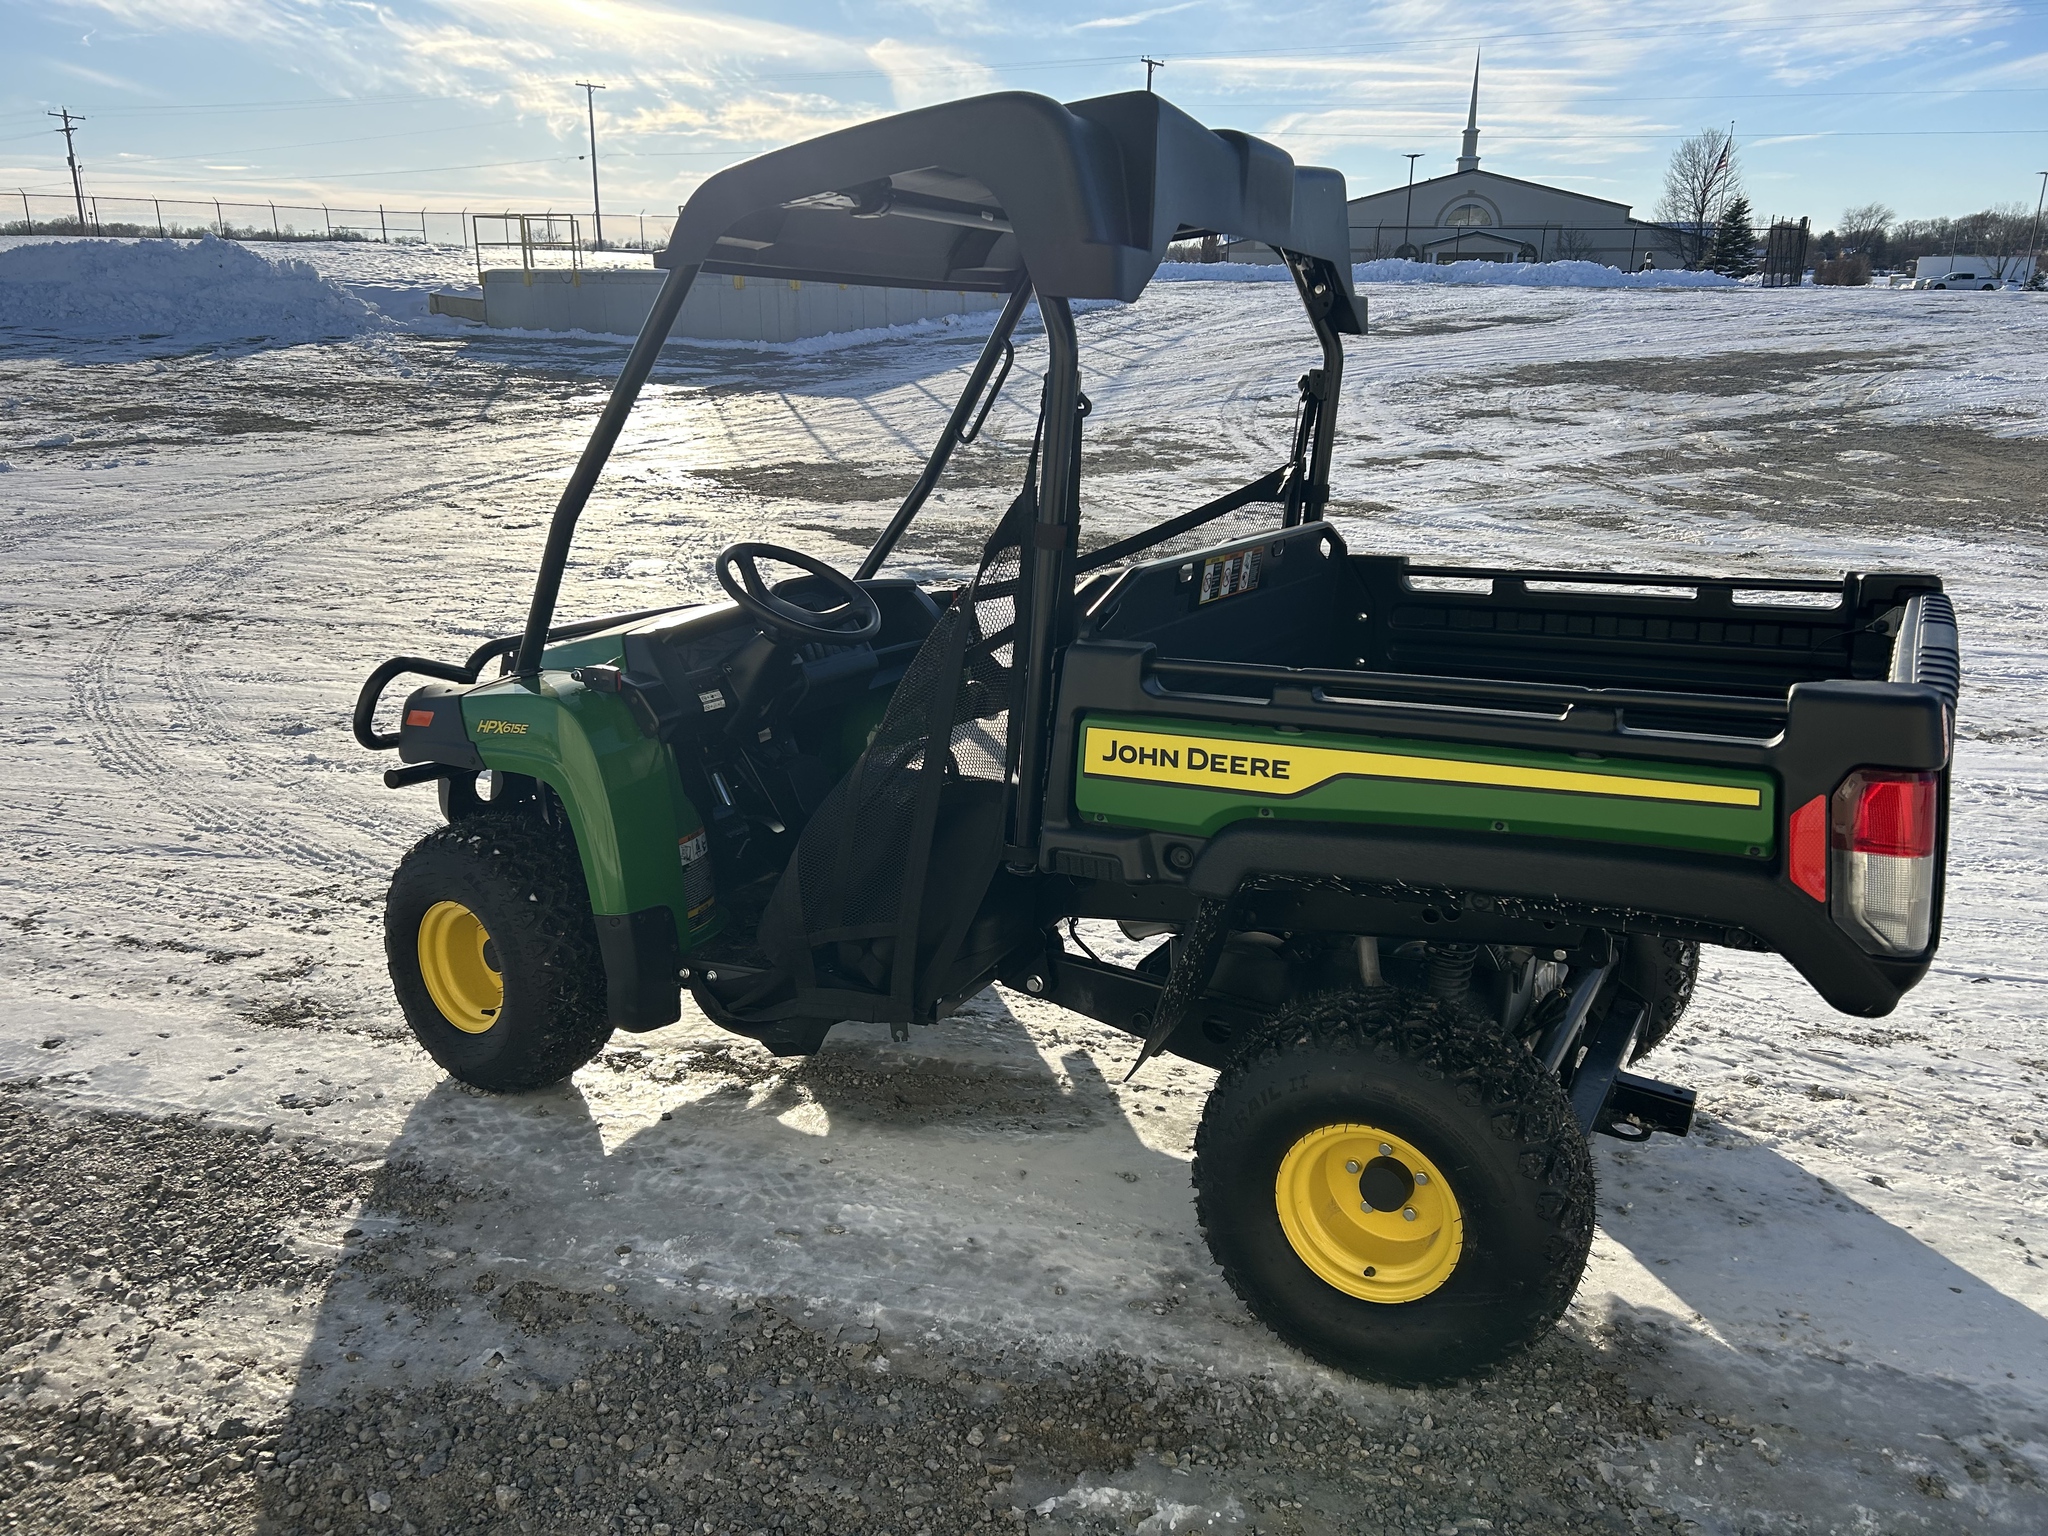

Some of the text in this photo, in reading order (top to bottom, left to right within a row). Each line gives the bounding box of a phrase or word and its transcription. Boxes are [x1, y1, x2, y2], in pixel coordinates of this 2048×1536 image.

[476, 719, 529, 735] HPX615E
[1102, 740, 1291, 780] JOHN DEERE
